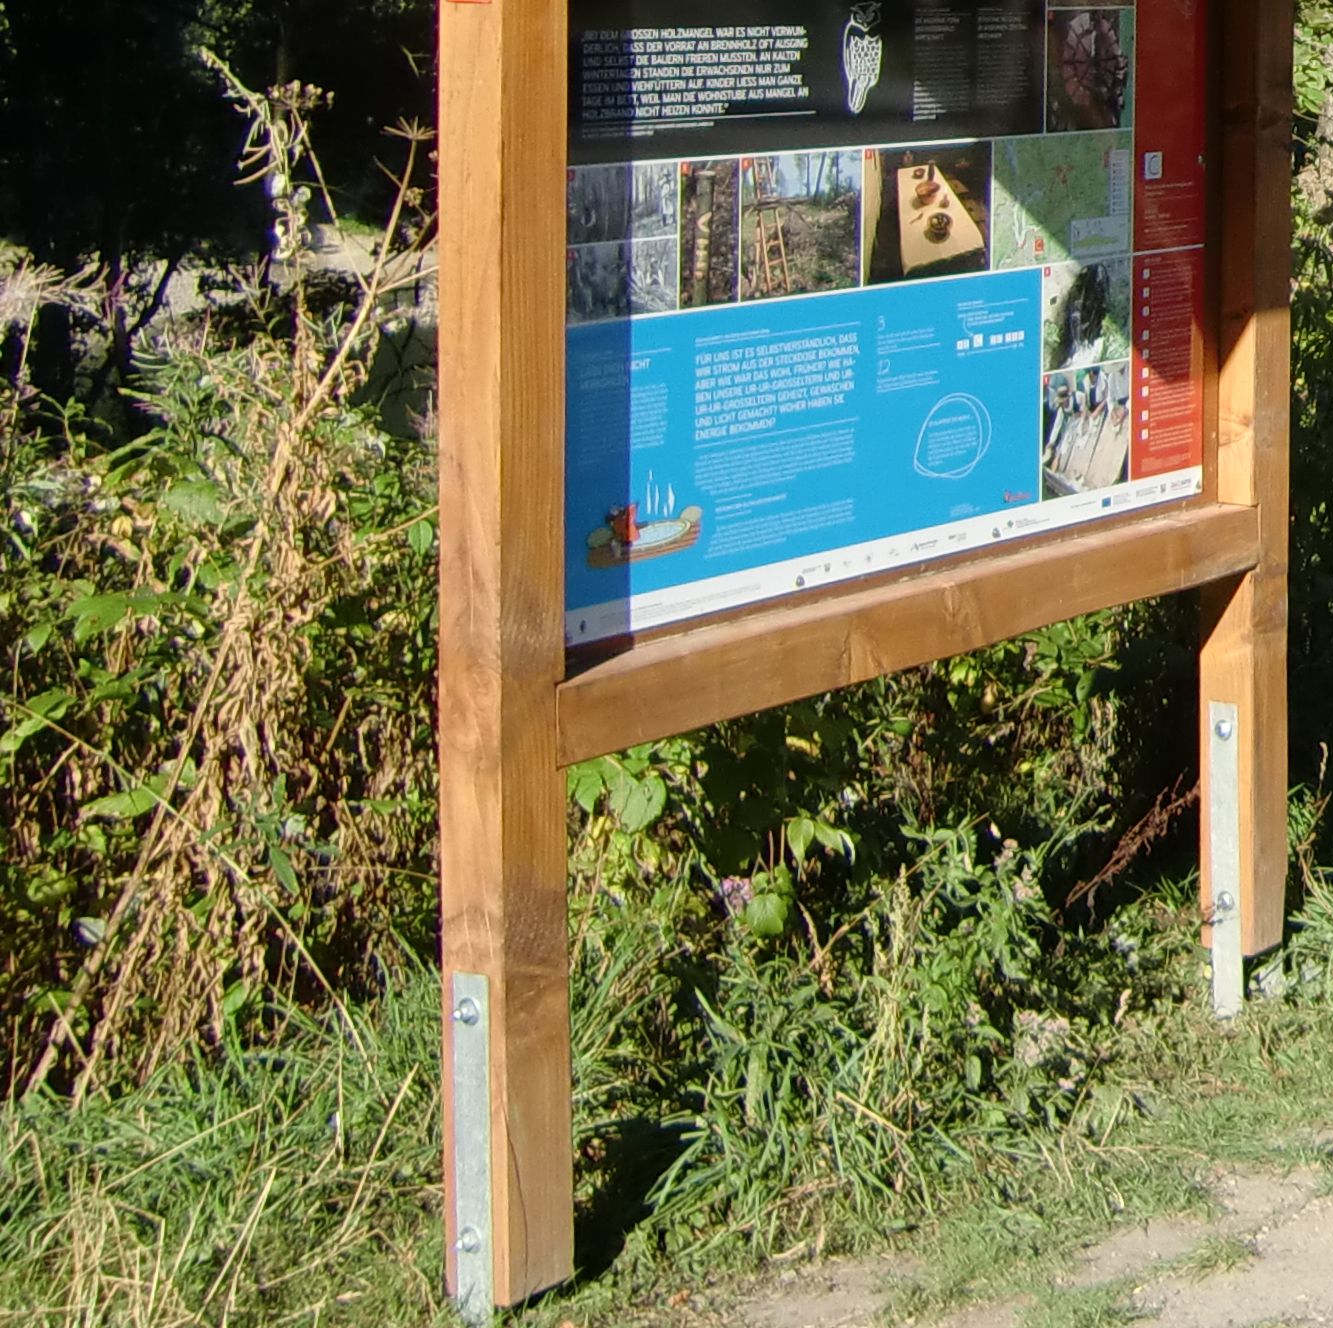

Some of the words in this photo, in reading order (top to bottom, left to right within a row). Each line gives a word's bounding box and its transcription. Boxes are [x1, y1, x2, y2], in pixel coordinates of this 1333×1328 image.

[660, 27, 714, 39] HOLZMANGEL
[716, 27, 734, 38] WAR
[735, 26, 745, 37] ES
[747, 26, 770, 37] NICHT
[646, 41, 663, 52] DER
[664, 40, 696, 52] VORRAT
[697, 40, 709, 51] AN
[710, 39, 758, 50] BRENNHOLZ
[759, 38, 774, 49] OFT
[775, 37, 809, 48] AUSGING
[635, 54, 650, 65] DIE
[651, 53, 684, 65] BAUERN
[685, 52, 719, 64] FRIEREN
[759, 51, 771, 61] AN
[642, 66, 680, 78] STANDEN
[681, 66, 695, 77] DIE
[696, 64, 754, 76] ERWACHSENEN
[755, 63, 772, 74] NUR
[774, 62, 791, 73] ZUM
[632, 79, 686, 92] VIEHFÜTTERN
[706, 77, 735, 88] KINDER
[736, 76, 757, 87] LIESS
[758, 75, 776, 86] MAN
[777, 74, 803, 85] GANZE
[640, 93, 661, 105] WEIL
[661, 92, 681, 104] MAN
[682, 91, 696, 103] DIE
[697, 89, 747, 101] WOHNSTUBE
[748, 88, 764, 99] AUS
[765, 87, 796, 98] MANGEL
[797, 87, 809, 97] AN
[635, 105, 660, 117] NICHT
[661, 104, 690, 116] HEIZEN
[696, 353, 711, 365] FÜR
[713, 350, 729, 362] UNS
[732, 349, 743, 359] IST
[745, 348, 754, 358] ES
[838, 333, 857, 344] DASS
[696, 366, 711, 378] WIR
[713, 363, 740, 375] STROM
[742, 360, 757, 371] AUS
[759, 357, 773, 368] DER
[775, 351, 816, 365] STECKDOSE
[696, 377, 716, 390] ABER
[718, 375, 732, 386] WIE
[734, 372, 752, 384] WAR
[753, 370, 768, 381] DAS
[828, 358, 842, 369] WIE
[843, 357, 856, 367] HA-
[696, 391, 711, 403] BEN
[713, 386, 743, 400] UNSERE
[825, 371, 840, 381] UND
[810, 381, 855, 396] GEWASCHEN
[696, 416, 713, 427] UND
[715, 413, 736, 425] LICHT
[738, 407, 777, 421] GEMACHT?
[779, 401, 807, 413] WOHER
[808, 397, 833, 409] HABEN
[834, 394, 844, 405] SIE
[696, 426, 728, 440] ENERGIE
[729, 418, 776, 433] BEKOMMEN?
